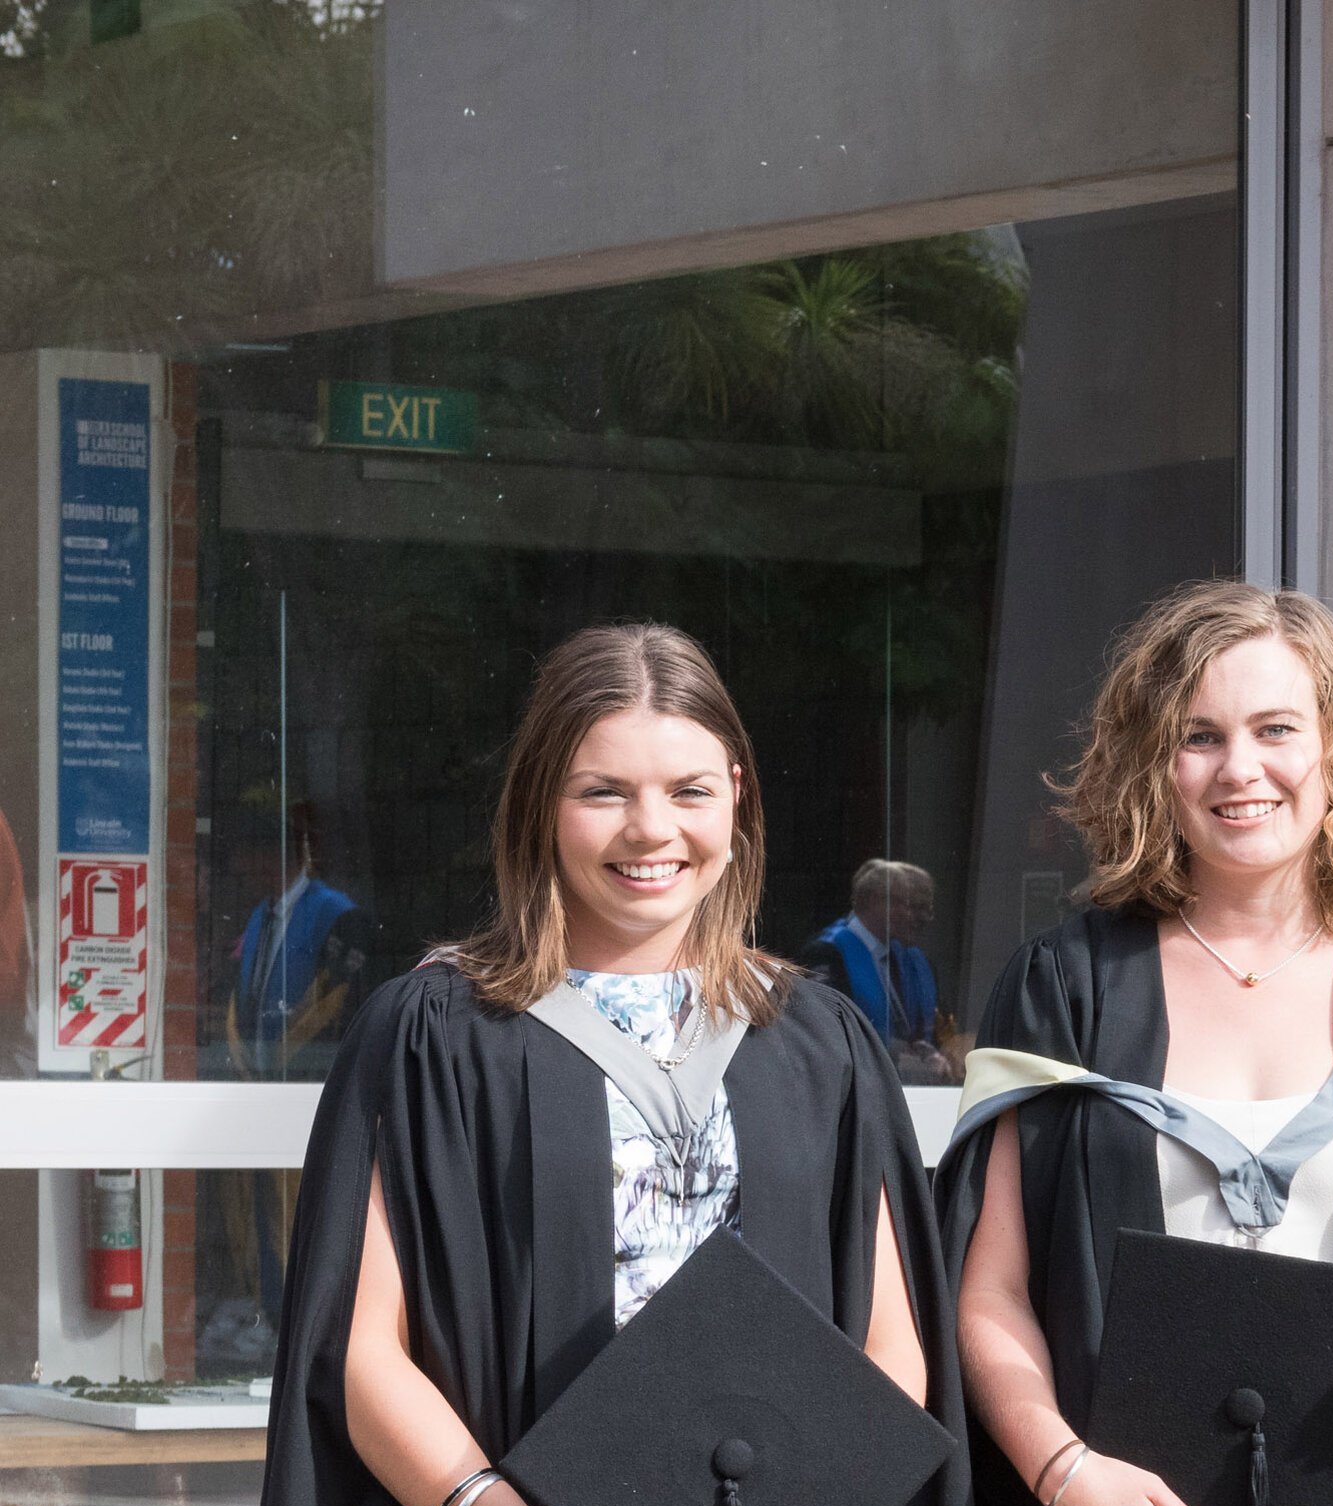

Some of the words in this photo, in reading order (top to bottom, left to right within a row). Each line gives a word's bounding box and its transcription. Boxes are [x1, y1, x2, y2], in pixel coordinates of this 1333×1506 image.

[362, 394, 441, 440] EXIT
[78, 450, 146, 468] ARCHITECTURE
[62, 503, 104, 520] GROUND
[106, 505, 138, 523] FLOOR
[80, 633, 113, 652] FLOOR
[75, 945, 104, 954] CARBON
[71, 955, 86, 963] FIRE
